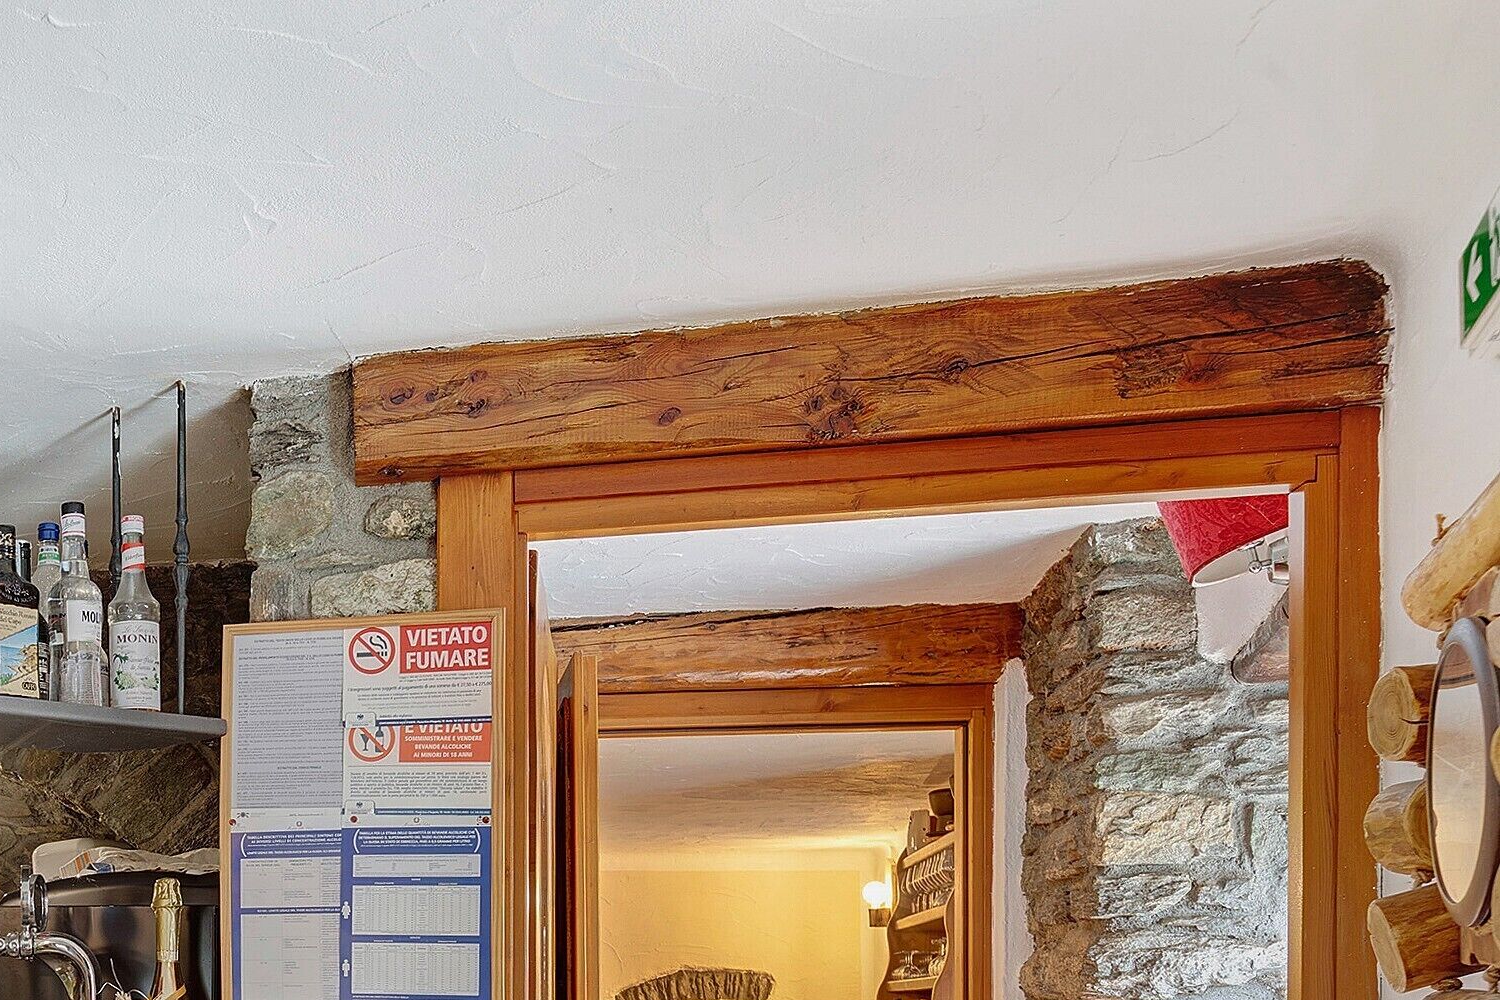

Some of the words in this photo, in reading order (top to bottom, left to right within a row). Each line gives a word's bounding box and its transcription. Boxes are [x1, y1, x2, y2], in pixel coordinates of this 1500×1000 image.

[117, 634, 157, 643] MONIN
[406, 626, 487, 646] VIETATO
[406, 648, 489, 670] FUMARE
